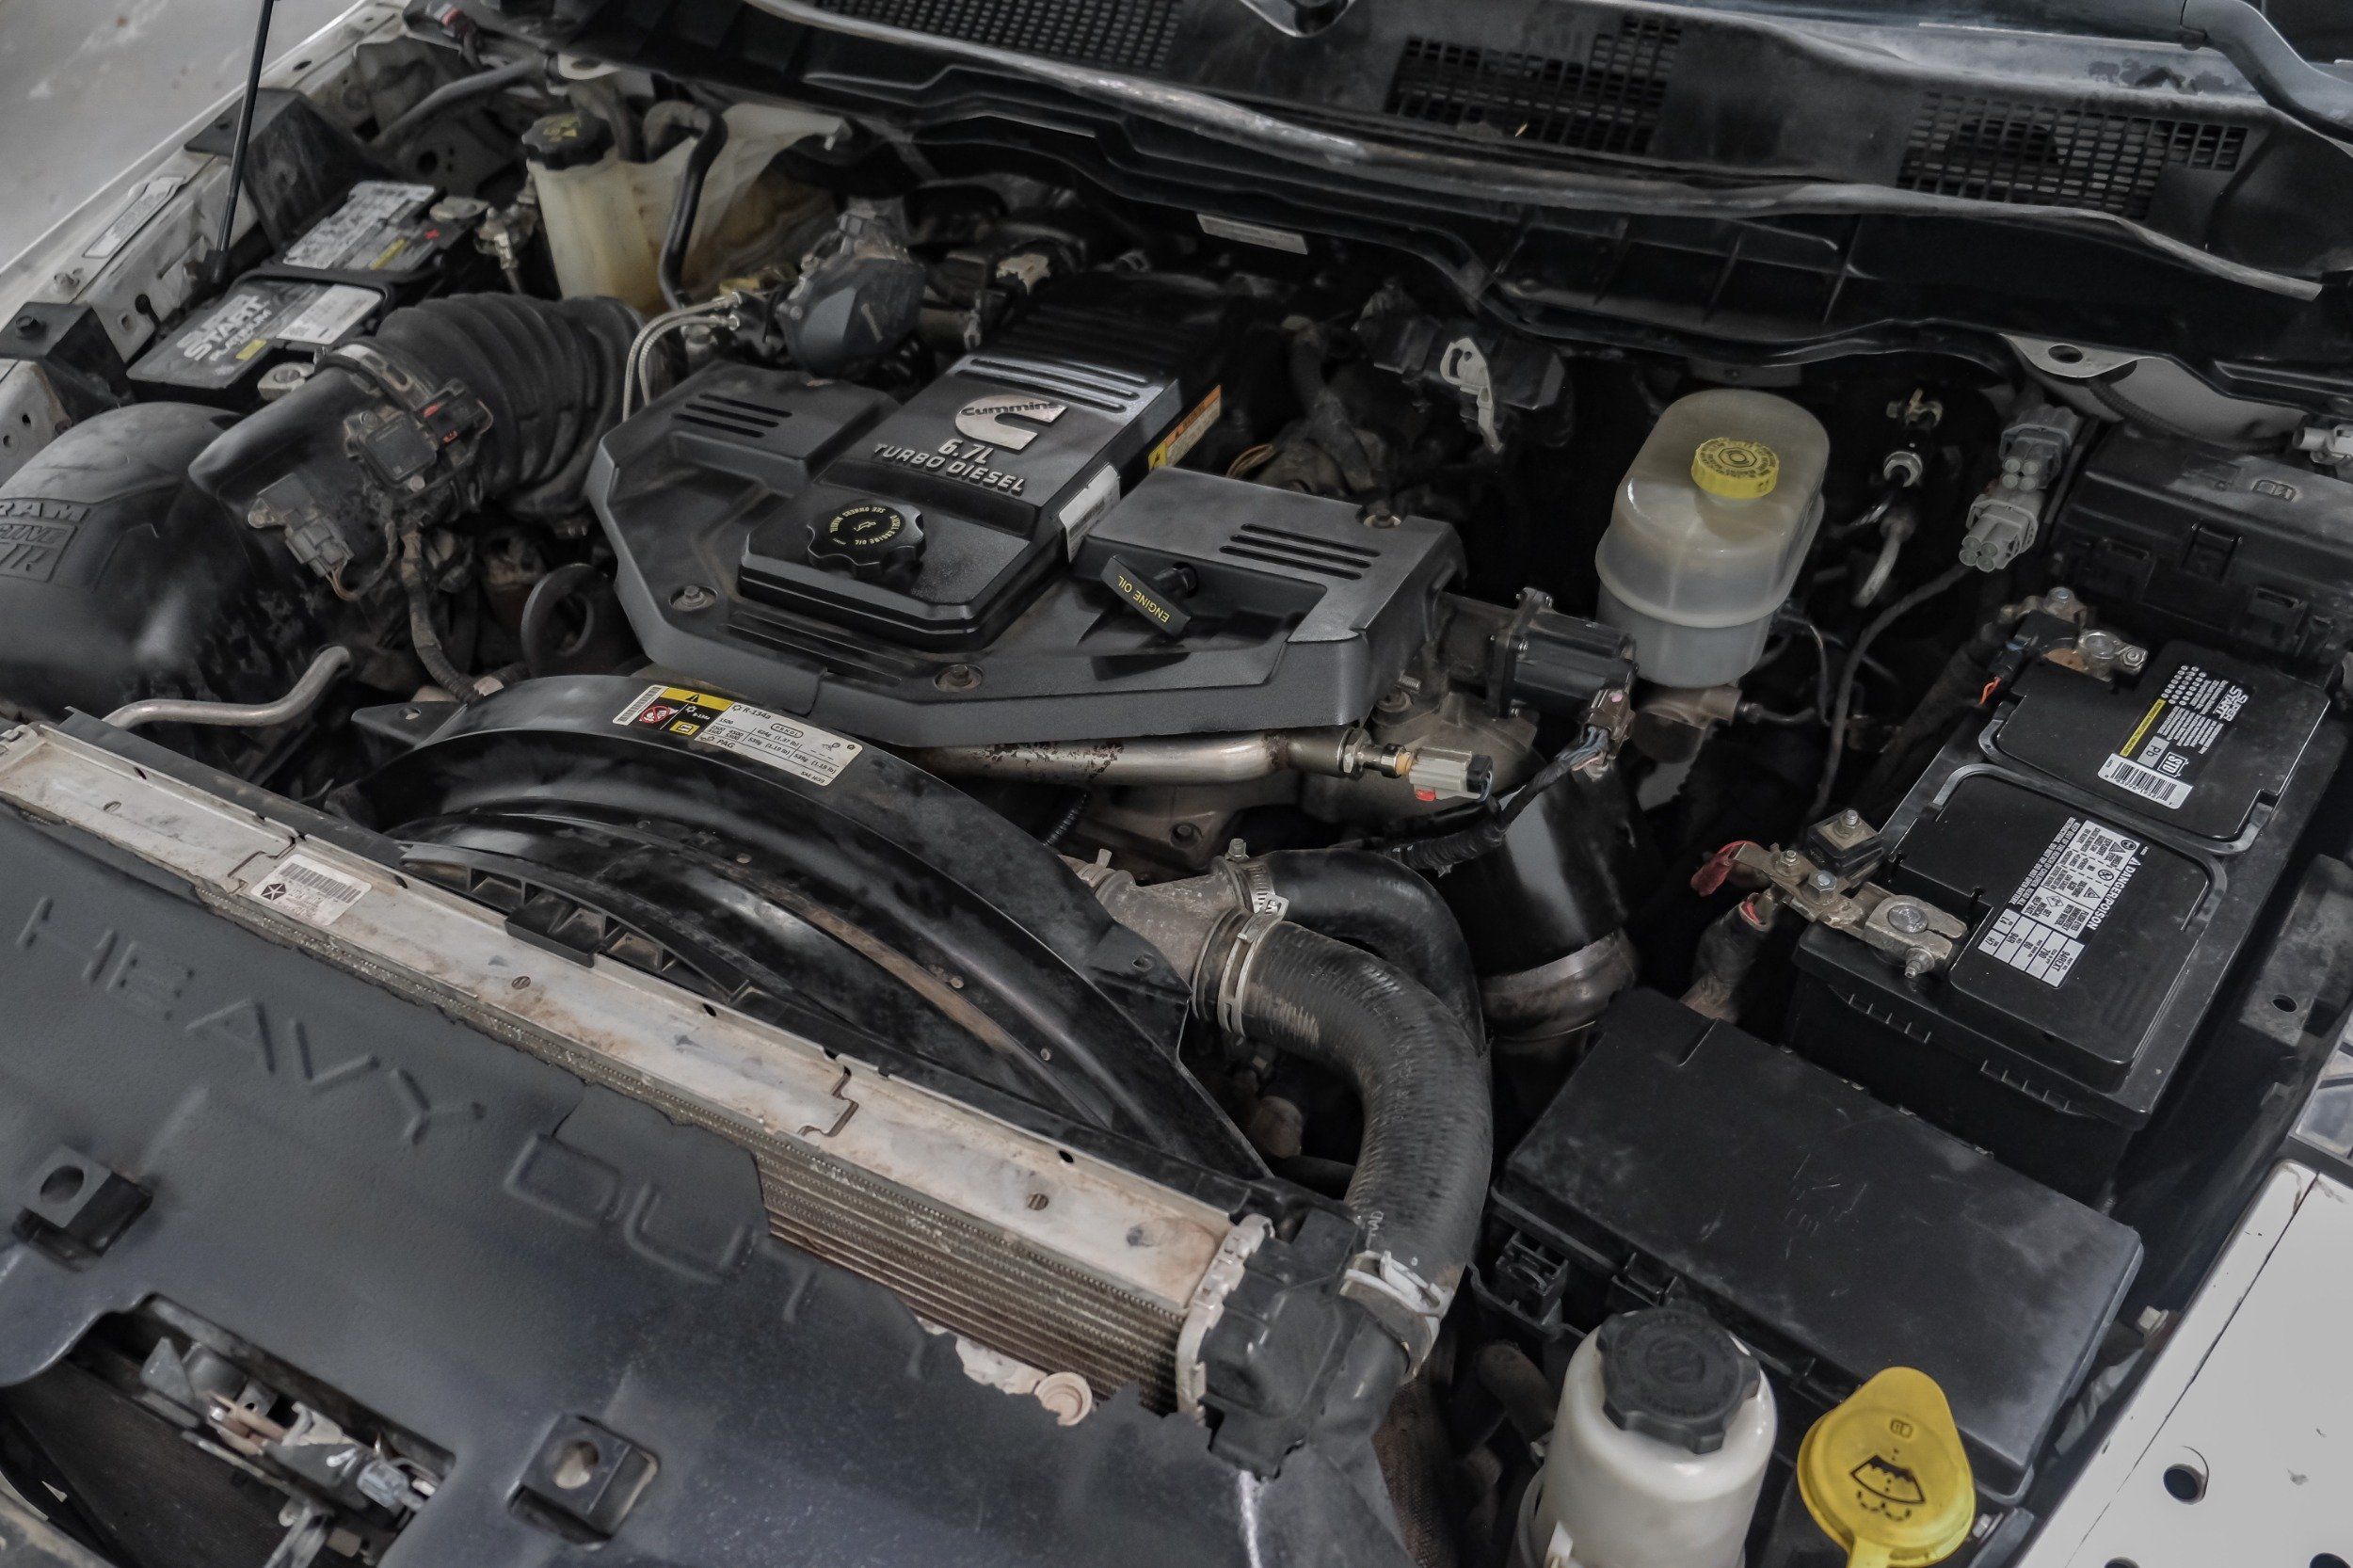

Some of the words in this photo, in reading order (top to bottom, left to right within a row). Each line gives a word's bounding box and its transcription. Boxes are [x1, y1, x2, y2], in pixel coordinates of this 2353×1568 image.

[937, 439, 994, 465] 6.7L
[873, 443, 946, 469] TURBO
[946, 460, 1026, 493] DIESEL
[1117, 575, 1132, 593] OIL
[1132, 590, 1170, 623] ENGINE
[2214, 684, 2243, 719] START
[2223, 693, 2248, 722] SUPER
[742, 707, 772, 720] R-134a
[716, 739, 735, 749] PAG
[2145, 744, 2161, 758] Pb
[2162, 756, 2182, 774] STD
[2086, 864, 2136, 930] DANGER/POISON
[1985, 936, 1995, 945] H7
[2006, 932, 2019, 944] 94R
[2037, 947, 2051, 959] 790
[2050, 950, 2070, 972] 94REXT
[14, 894, 488, 1147] HEAVY
